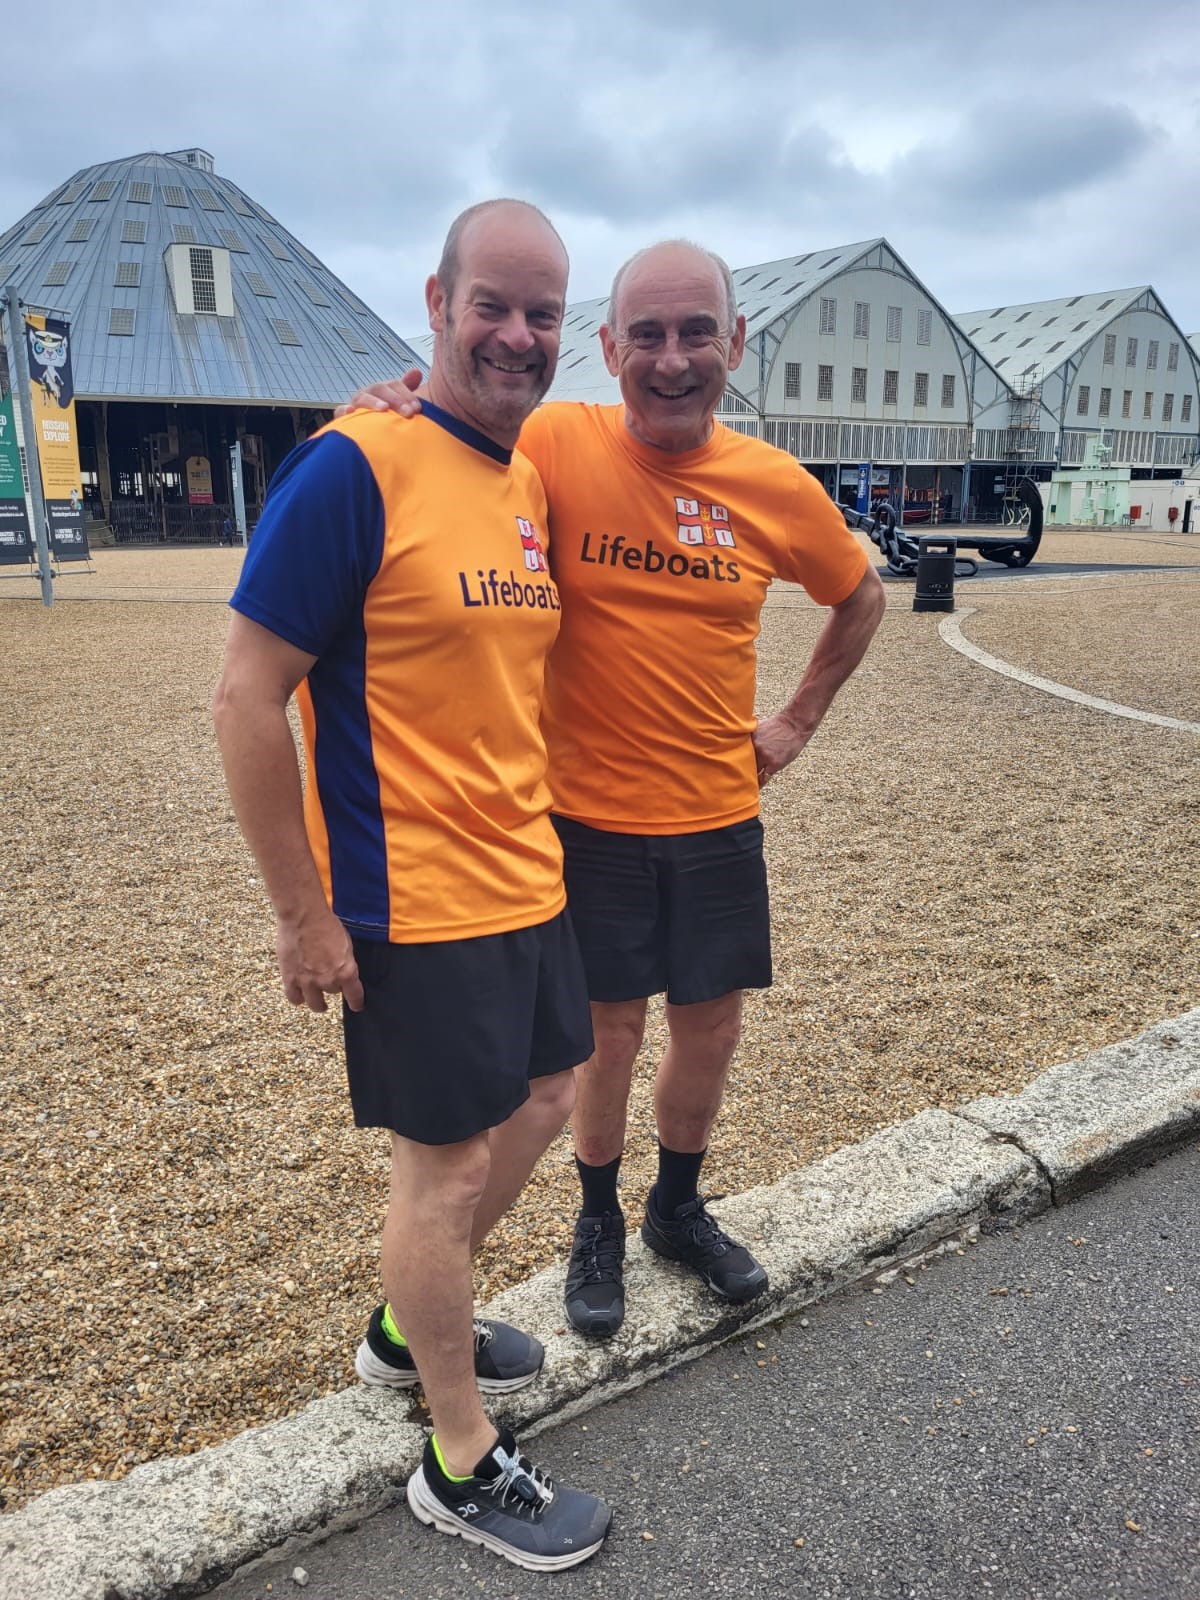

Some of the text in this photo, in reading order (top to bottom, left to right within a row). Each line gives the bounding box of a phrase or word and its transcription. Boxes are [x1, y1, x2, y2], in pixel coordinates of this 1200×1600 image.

[43, 431, 70, 442] EXPLORE
[580, 532, 741, 583] Lifeboats
[459, 569, 560, 610] Lifeboats
